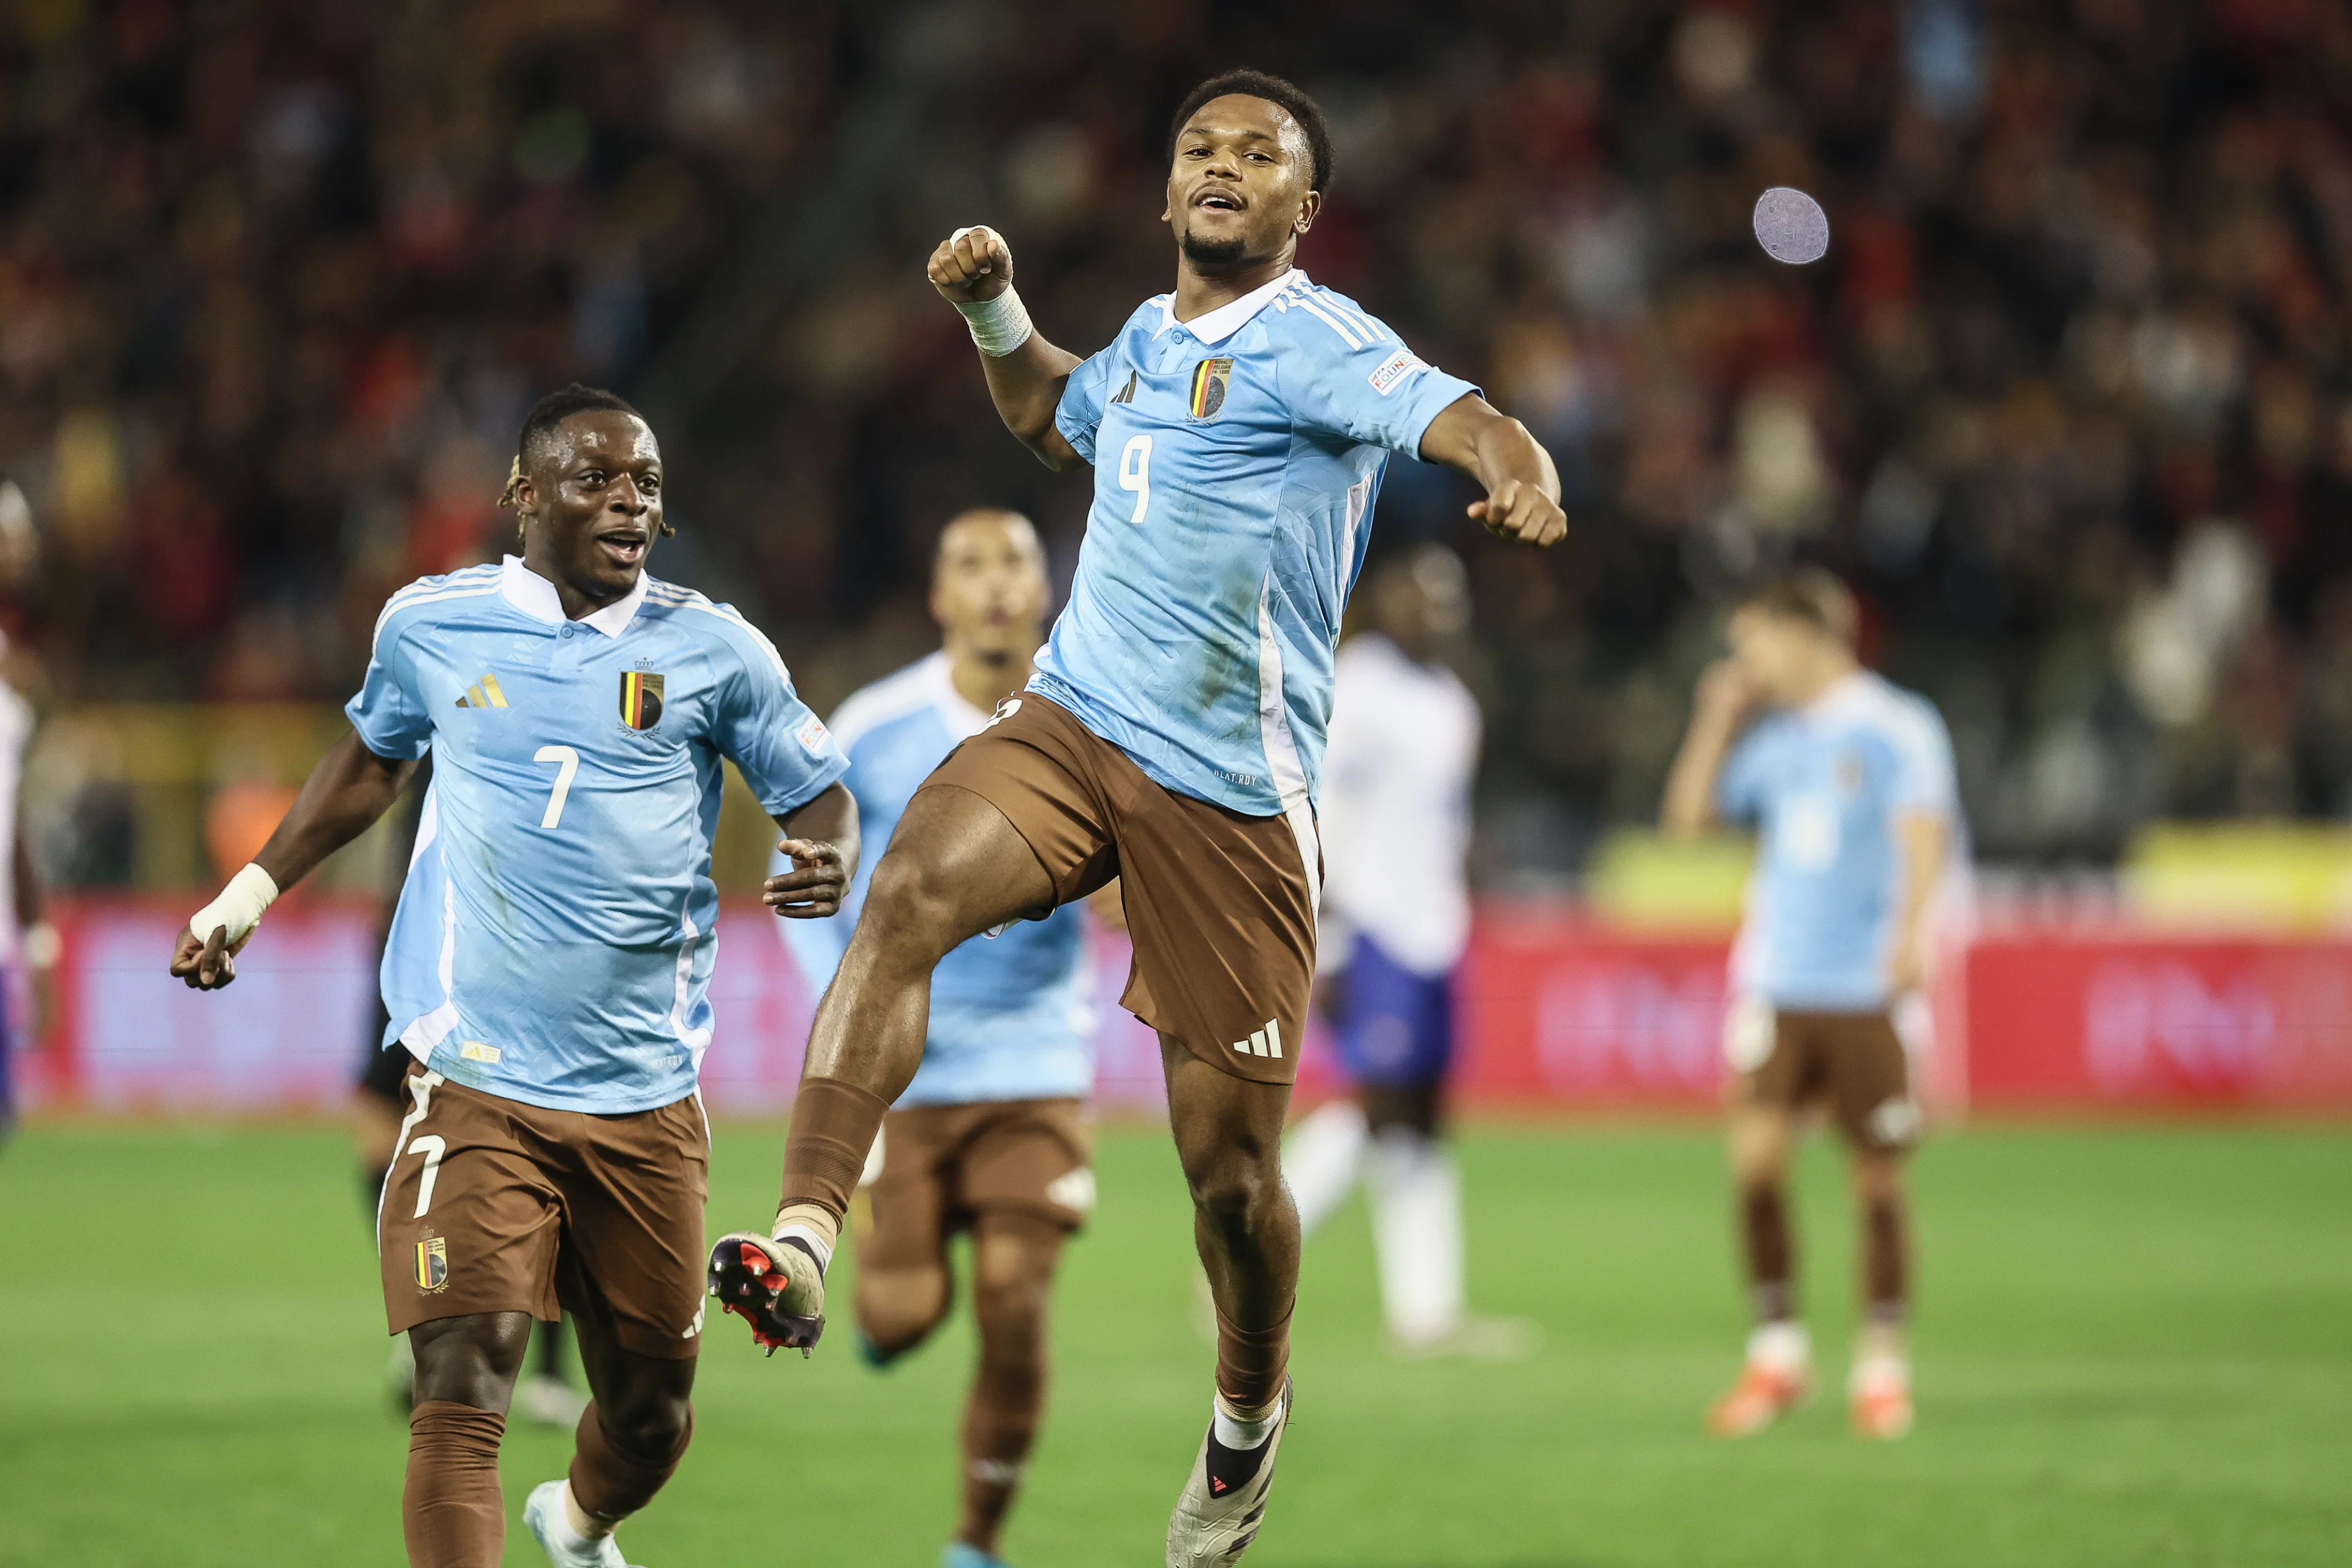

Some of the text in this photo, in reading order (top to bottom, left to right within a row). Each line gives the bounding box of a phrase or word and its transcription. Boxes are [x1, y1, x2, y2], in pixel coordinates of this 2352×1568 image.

[1118, 434, 1153, 524] 9
[533, 745, 580, 829] 7
[1214, 769, 1257, 786] HEAT.RDY
[407, 1134, 447, 1219] 7
